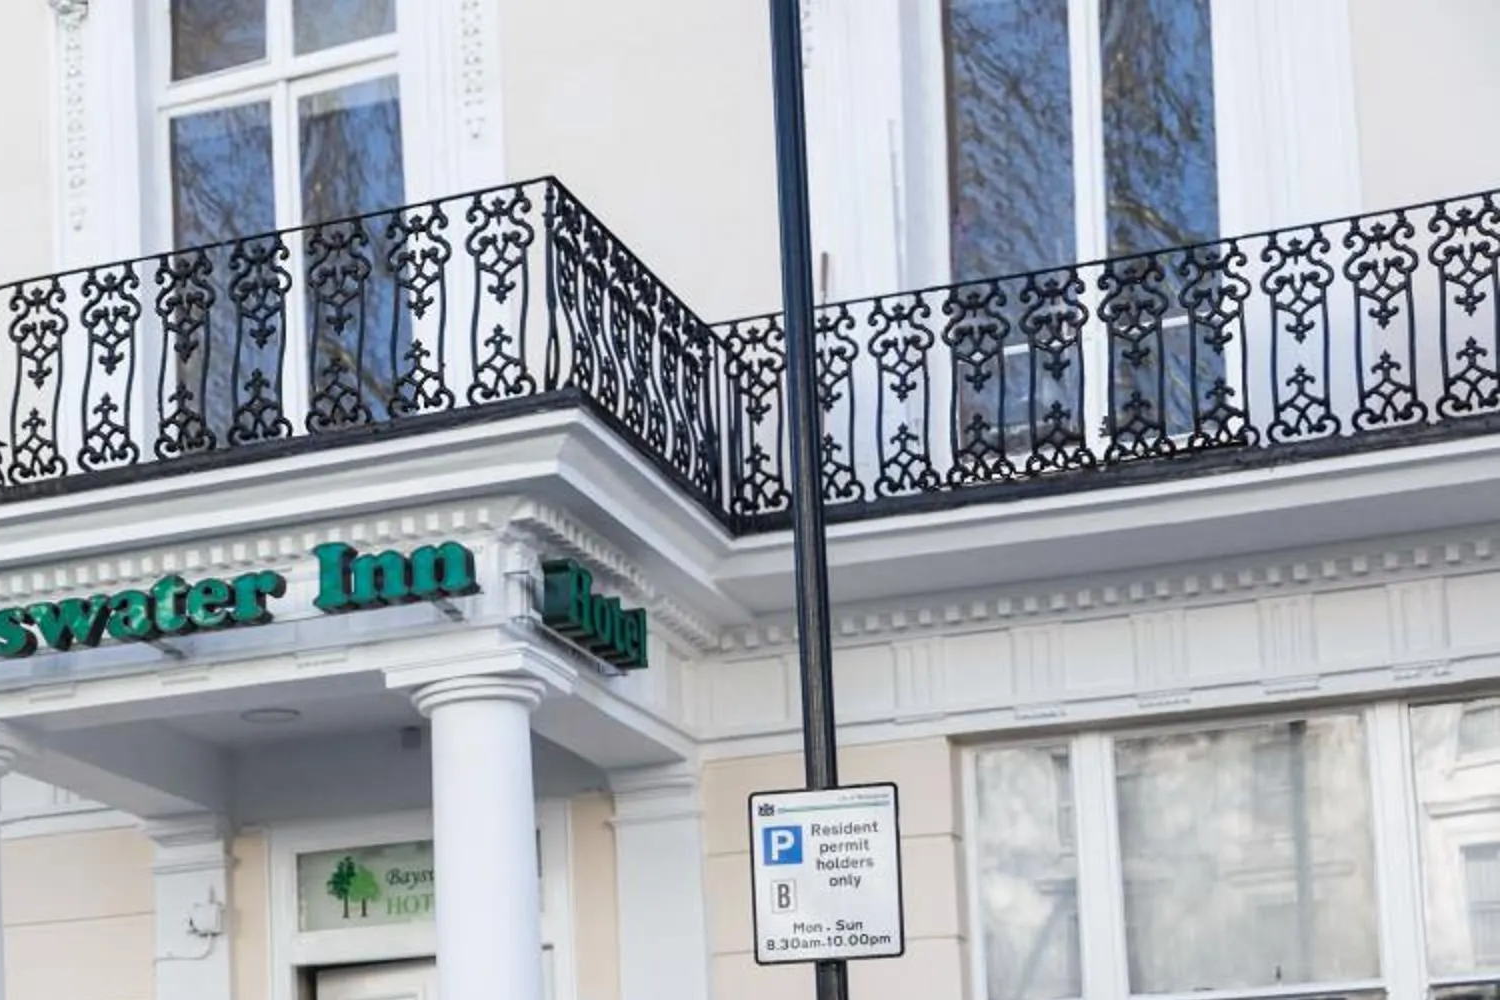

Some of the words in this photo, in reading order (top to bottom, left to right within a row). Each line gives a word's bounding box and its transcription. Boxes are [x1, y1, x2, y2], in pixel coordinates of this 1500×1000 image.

[313, 540, 479, 612] Inn
[543, 558, 648, 669] Hotel
[811, 821, 879, 837] Resident
[771, 829, 795, 861] P
[819, 839, 870, 855] permit
[816, 856, 875, 871] holders
[829, 874, 862, 889] only
[387, 893, 434, 915] HOT
[778, 883, 791, 908] B
[793, 922, 823, 934] Mon
[835, 919, 863, 932] Sun
